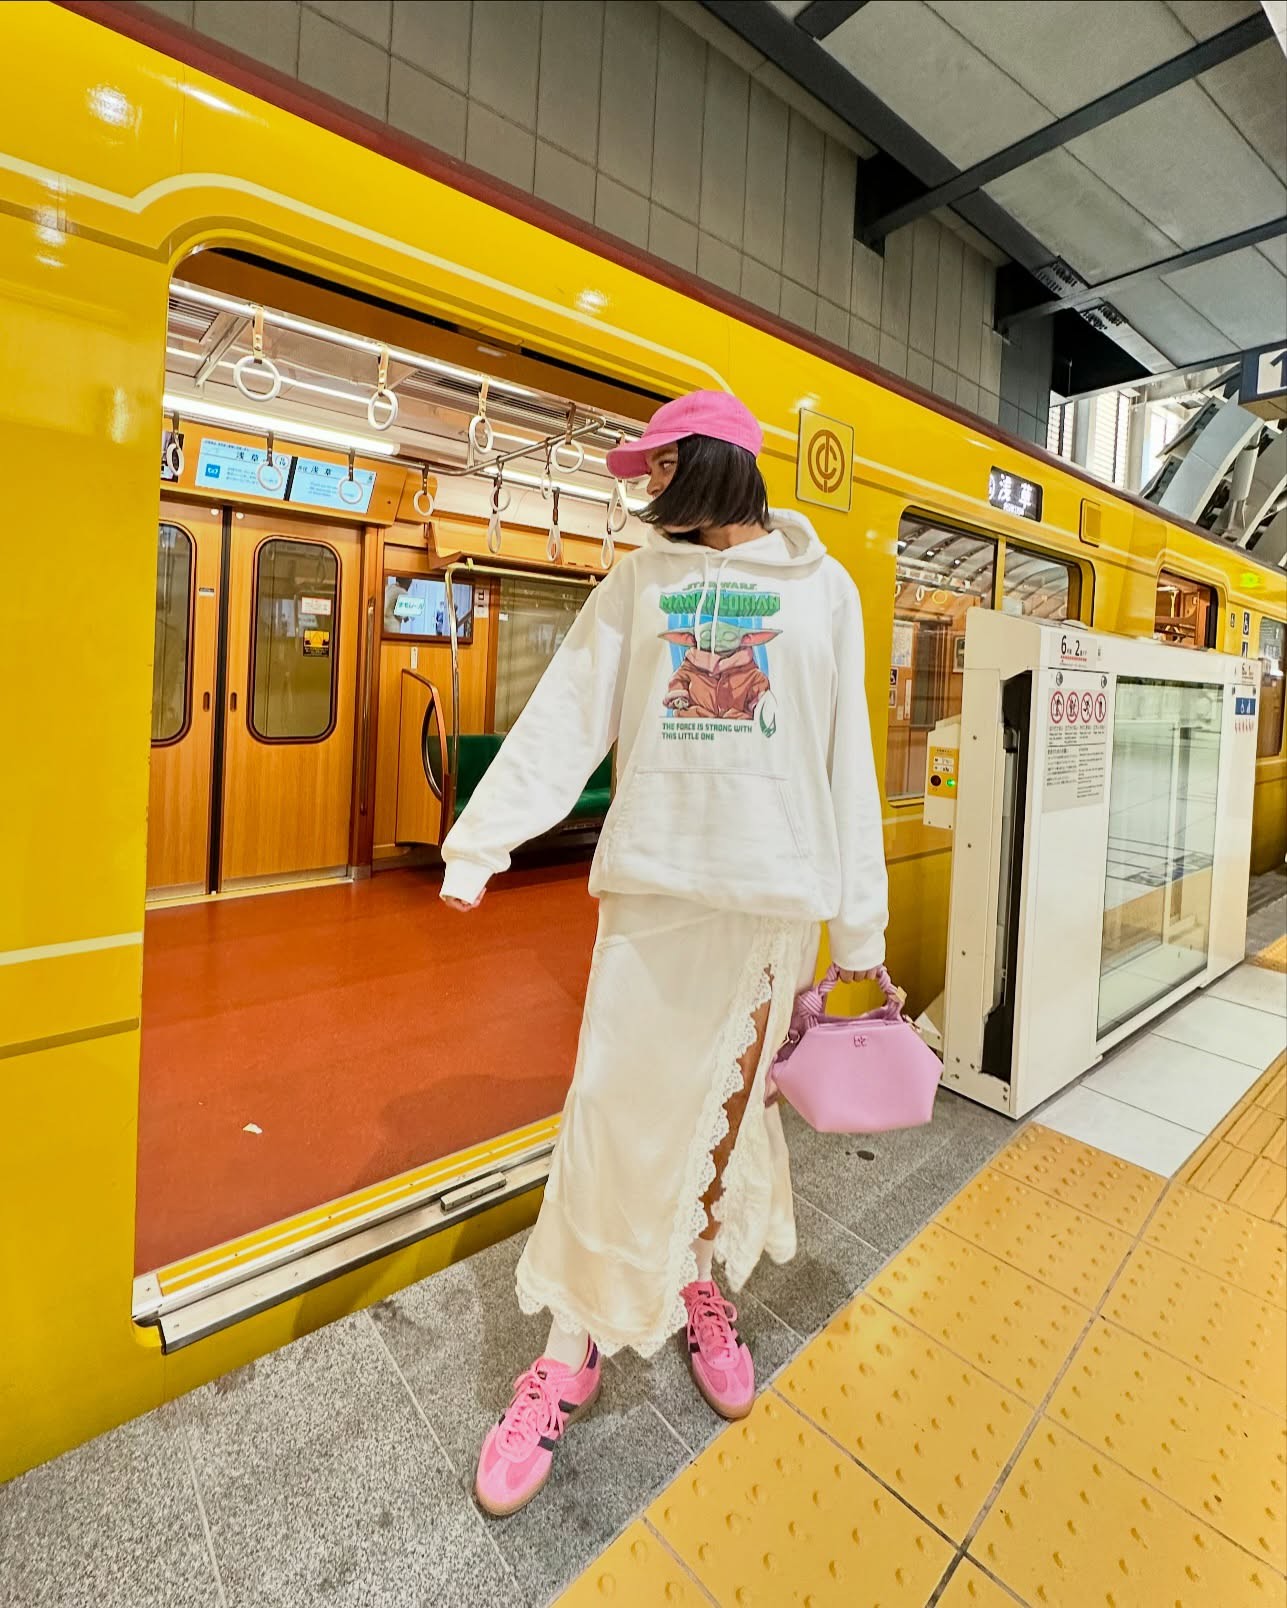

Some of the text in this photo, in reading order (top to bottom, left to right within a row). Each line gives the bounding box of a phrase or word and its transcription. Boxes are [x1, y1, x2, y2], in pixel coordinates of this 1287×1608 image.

[998, 473, 1033, 510] 浅草
[662, 722, 753, 733] THE FORCE IS STRONG WITH
[662, 732, 676, 740] THIS
[700, 733, 715, 741] ONE
